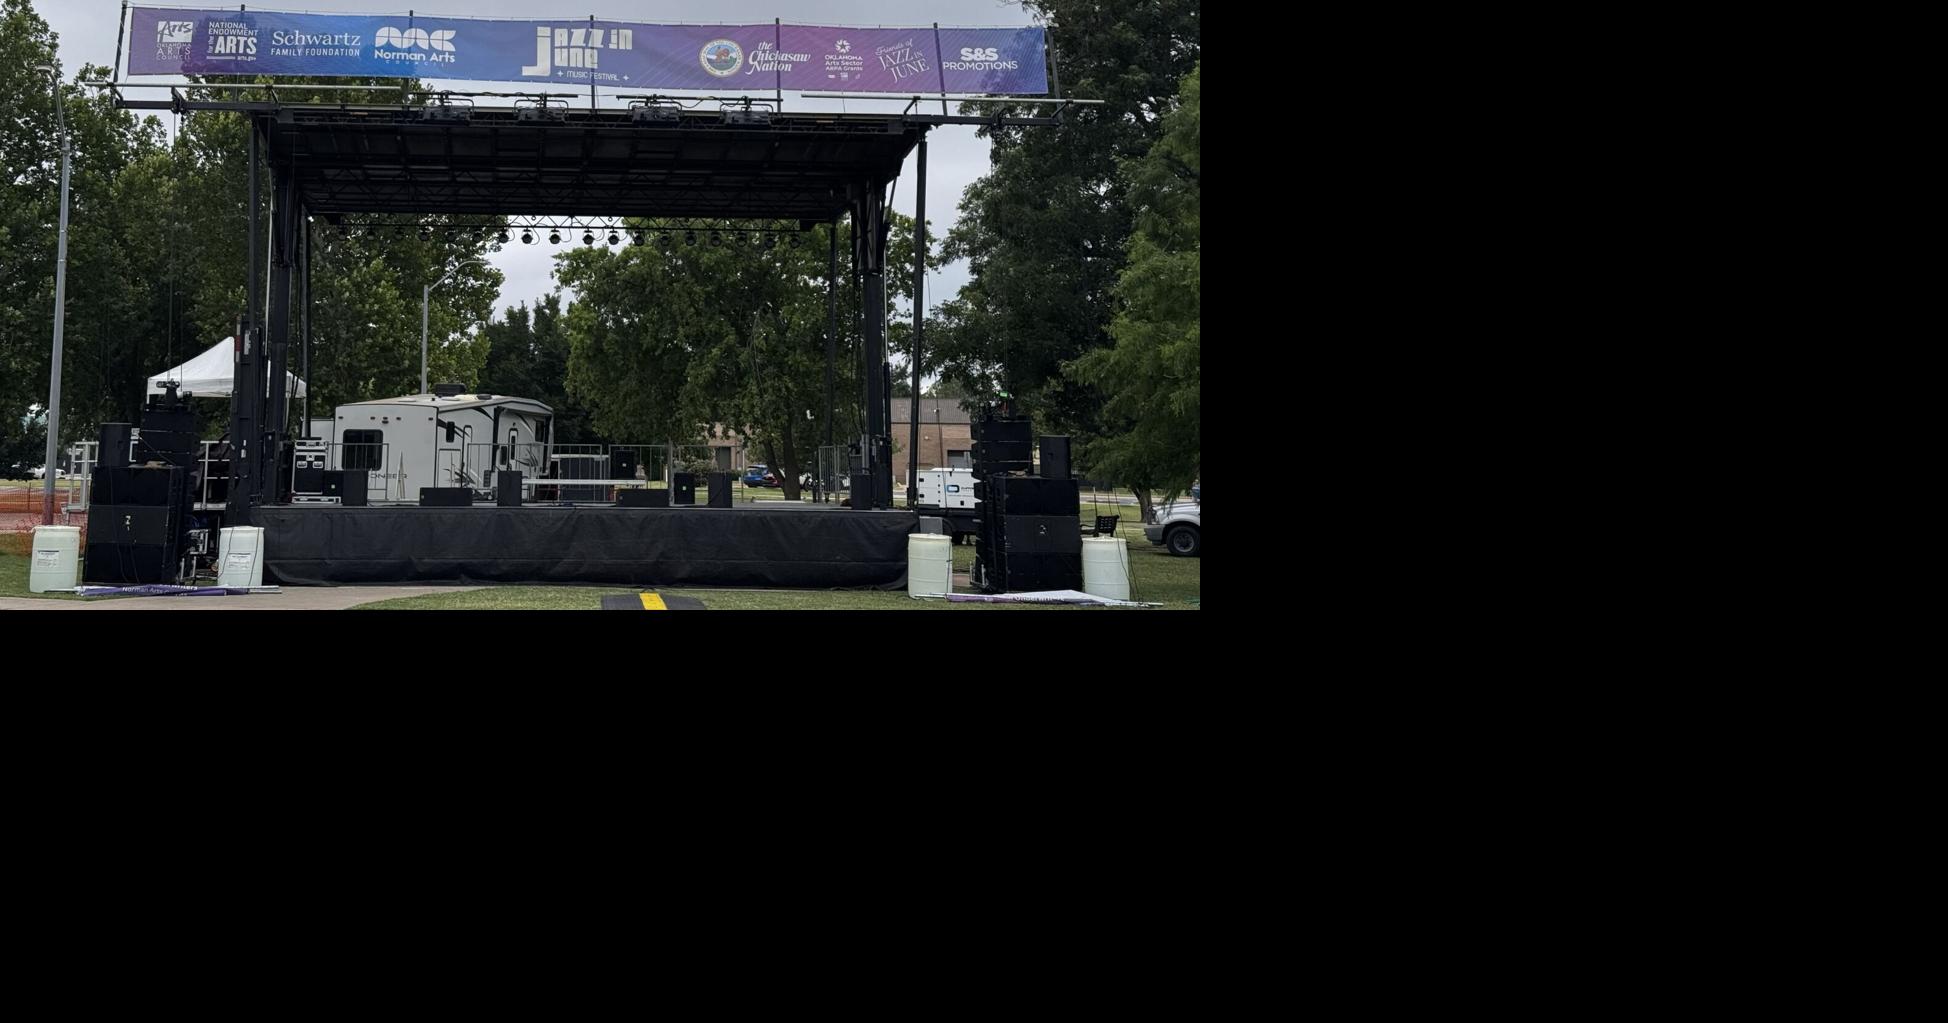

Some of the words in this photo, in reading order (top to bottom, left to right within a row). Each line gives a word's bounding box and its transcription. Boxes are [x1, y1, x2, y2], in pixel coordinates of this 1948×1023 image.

[208, 21, 248, 30] NATIONAL
[208, 28, 258, 36] ENDOWMENT
[214, 35, 257, 55] ARTS
[272, 30, 361, 46] Schwartz
[156, 47, 191, 55] ARTS
[270, 48, 301, 56] FAMILY
[305, 48, 360, 57] FOUNDATION
[758, 41, 773, 50] the
[374, 49, 426, 61] Norman
[429, 52, 456, 63] Arts
[748, 50, 811, 64] Chickasaw
[880, 48, 914, 71] JAZZ
[960, 47, 998, 61] S&S
[745, 60, 792, 75] Nation
[891, 59, 930, 84] JUNE
[943, 61, 1018, 71] PROMOTIONS
[566, 70, 588, 79] MUSIC
[589, 72, 620, 81] FESTIVAL
